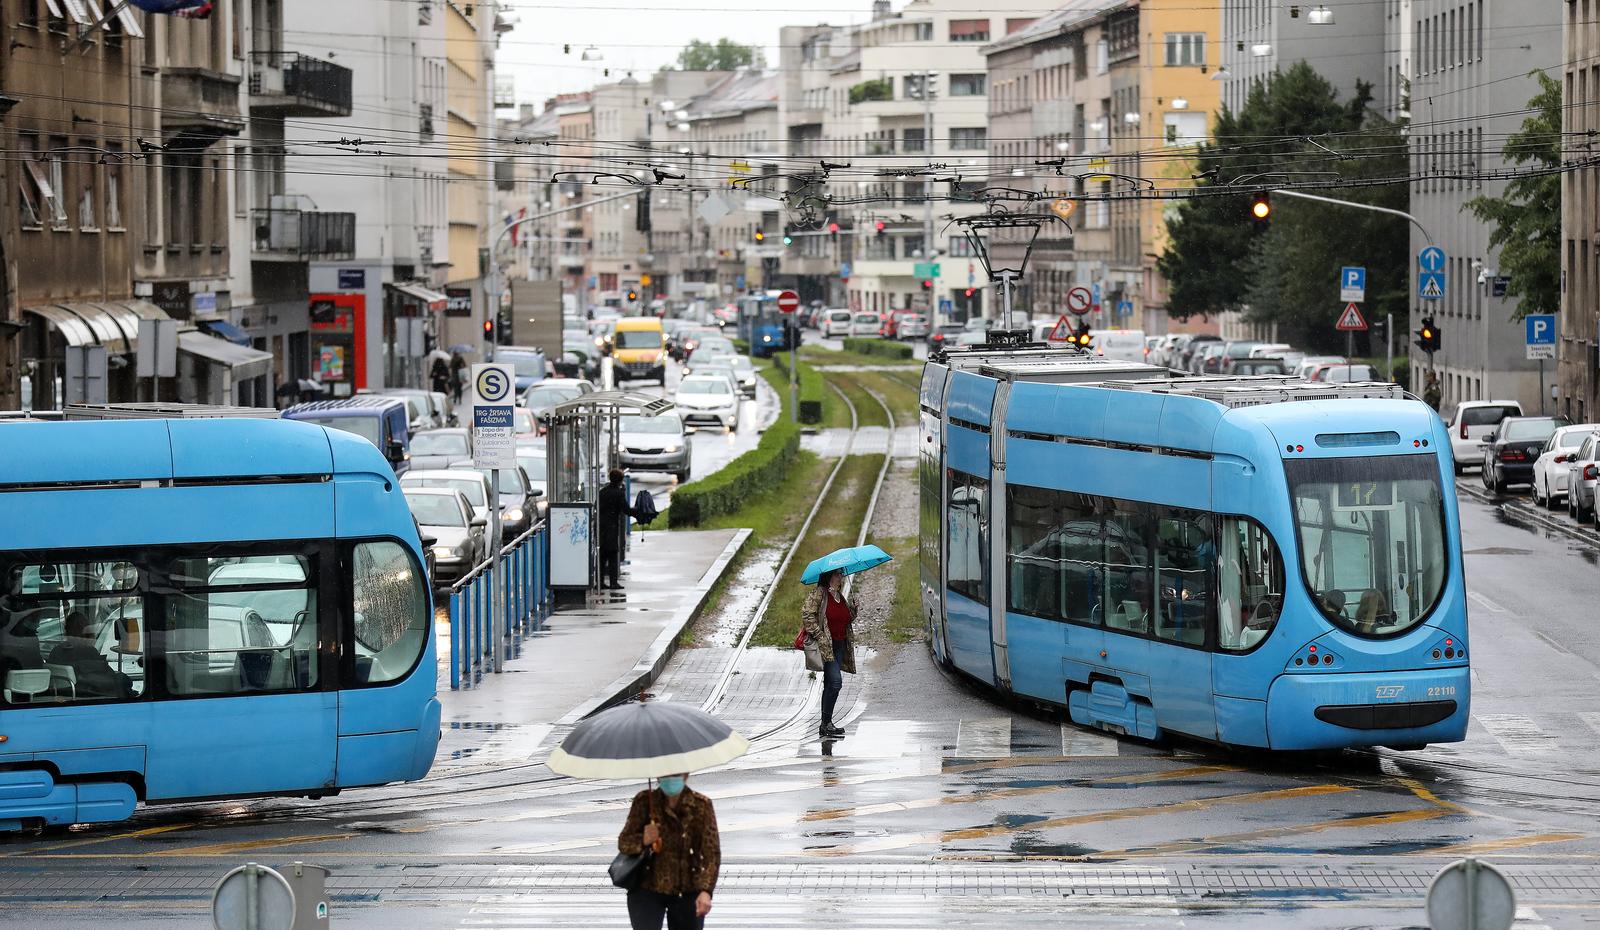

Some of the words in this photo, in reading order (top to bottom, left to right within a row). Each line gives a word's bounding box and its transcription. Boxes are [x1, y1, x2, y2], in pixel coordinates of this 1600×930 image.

[1348, 271, 1359, 286] P
[1534, 320, 1547, 339] P
[485, 375, 500, 394] S
[476, 409, 488, 417] TRG
[489, 408, 512, 417] ŽRTAVA
[480, 416, 507, 424] FAŠIZMA
[1351, 482, 1377, 505] 17
[1427, 686, 1456, 696] 22110
